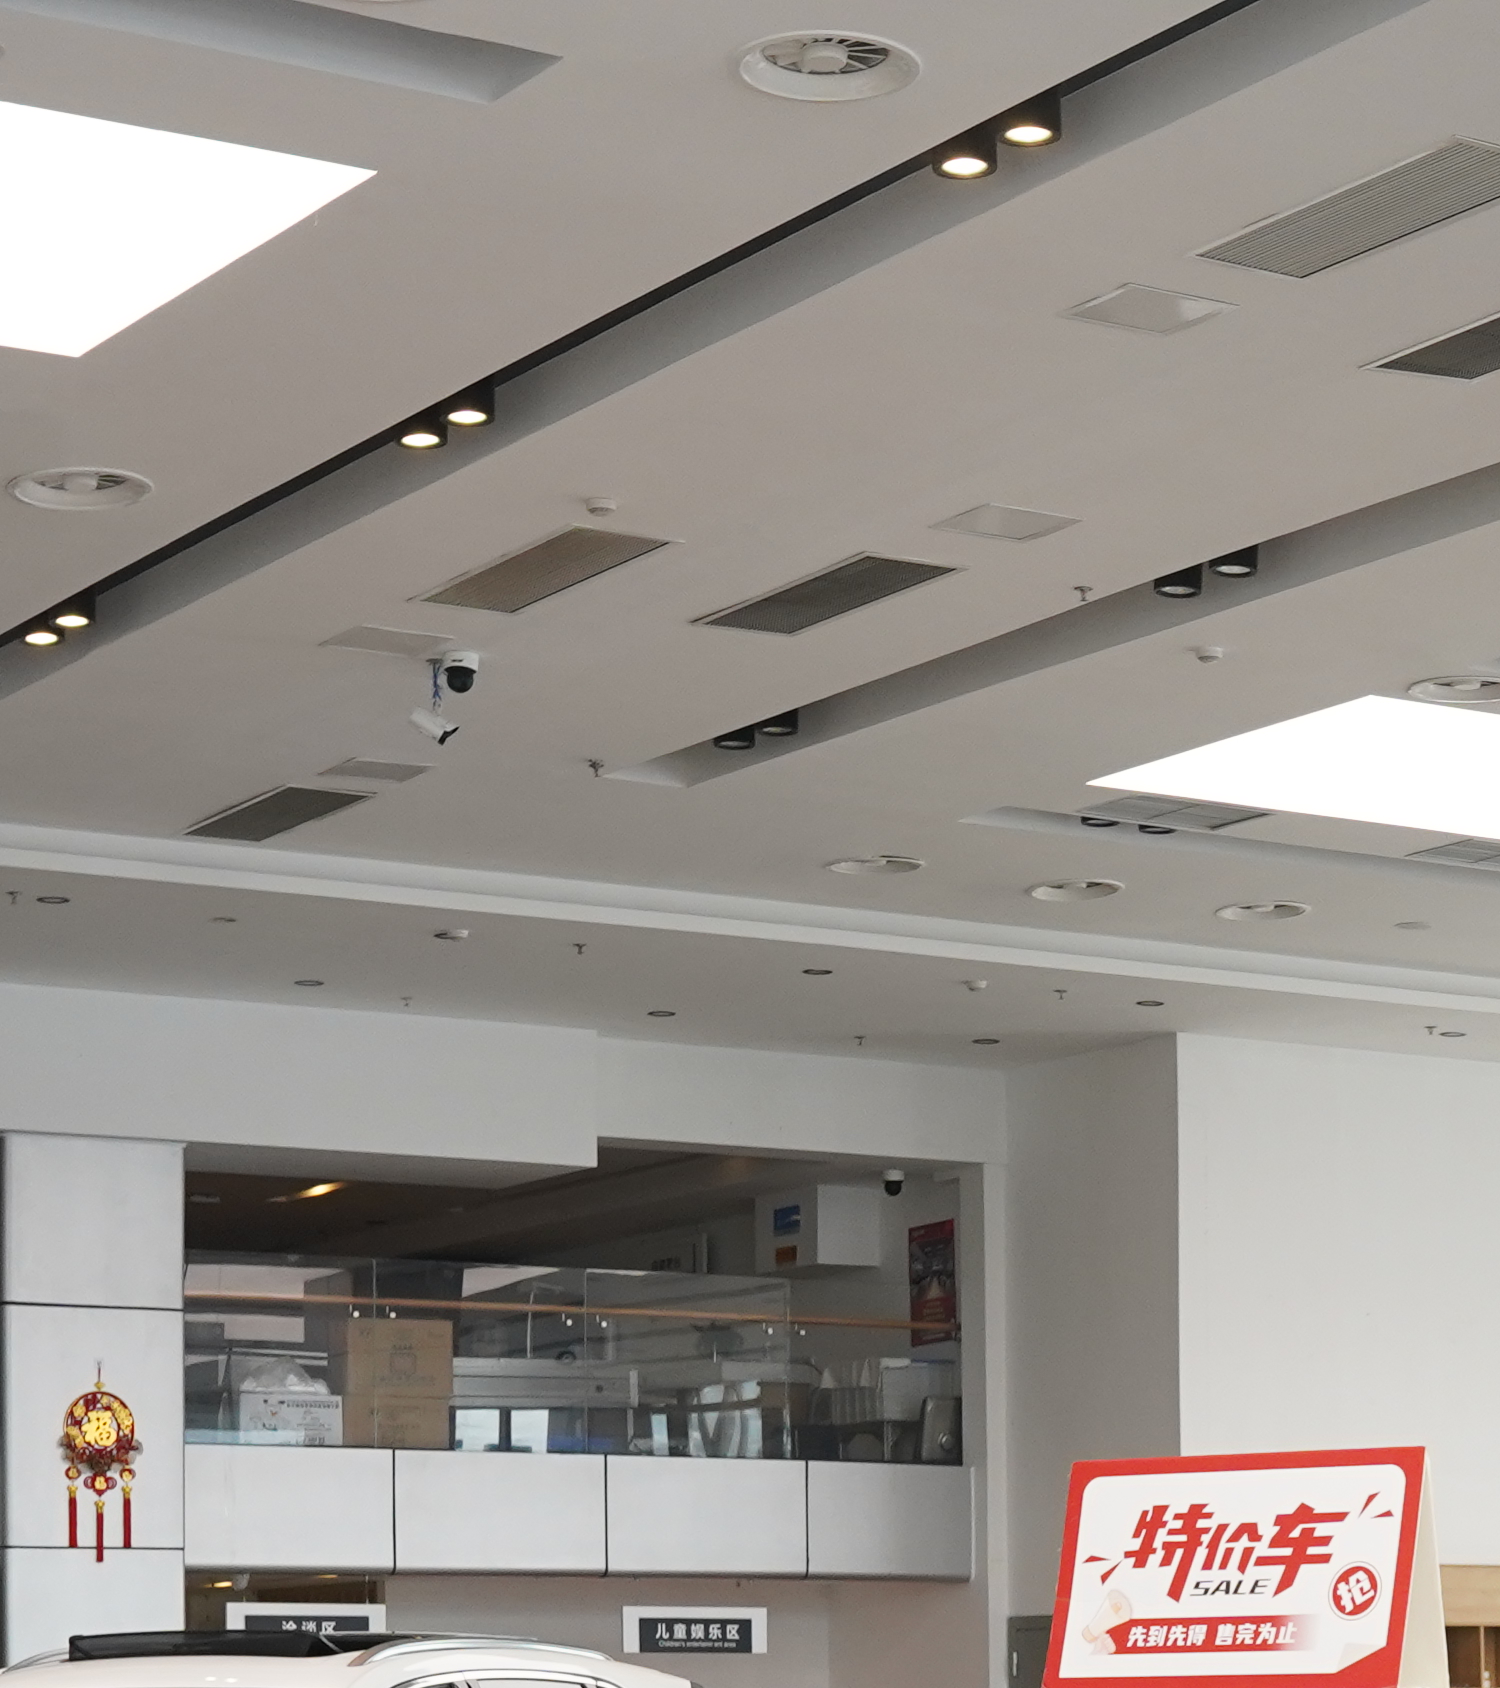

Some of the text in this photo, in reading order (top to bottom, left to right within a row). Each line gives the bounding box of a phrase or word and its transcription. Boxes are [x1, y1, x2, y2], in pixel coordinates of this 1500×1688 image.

[81, 1410, 117, 1446] 福
[1123, 1502, 1350, 1603] 特价车
[1189, 1578, 1272, 1597] SALE
[1336, 1571, 1376, 1613] 抢
[655, 1622, 740, 1640] 儿童娱乐区
[1126, 1622, 1298, 1648] 先到先得 售完为止
